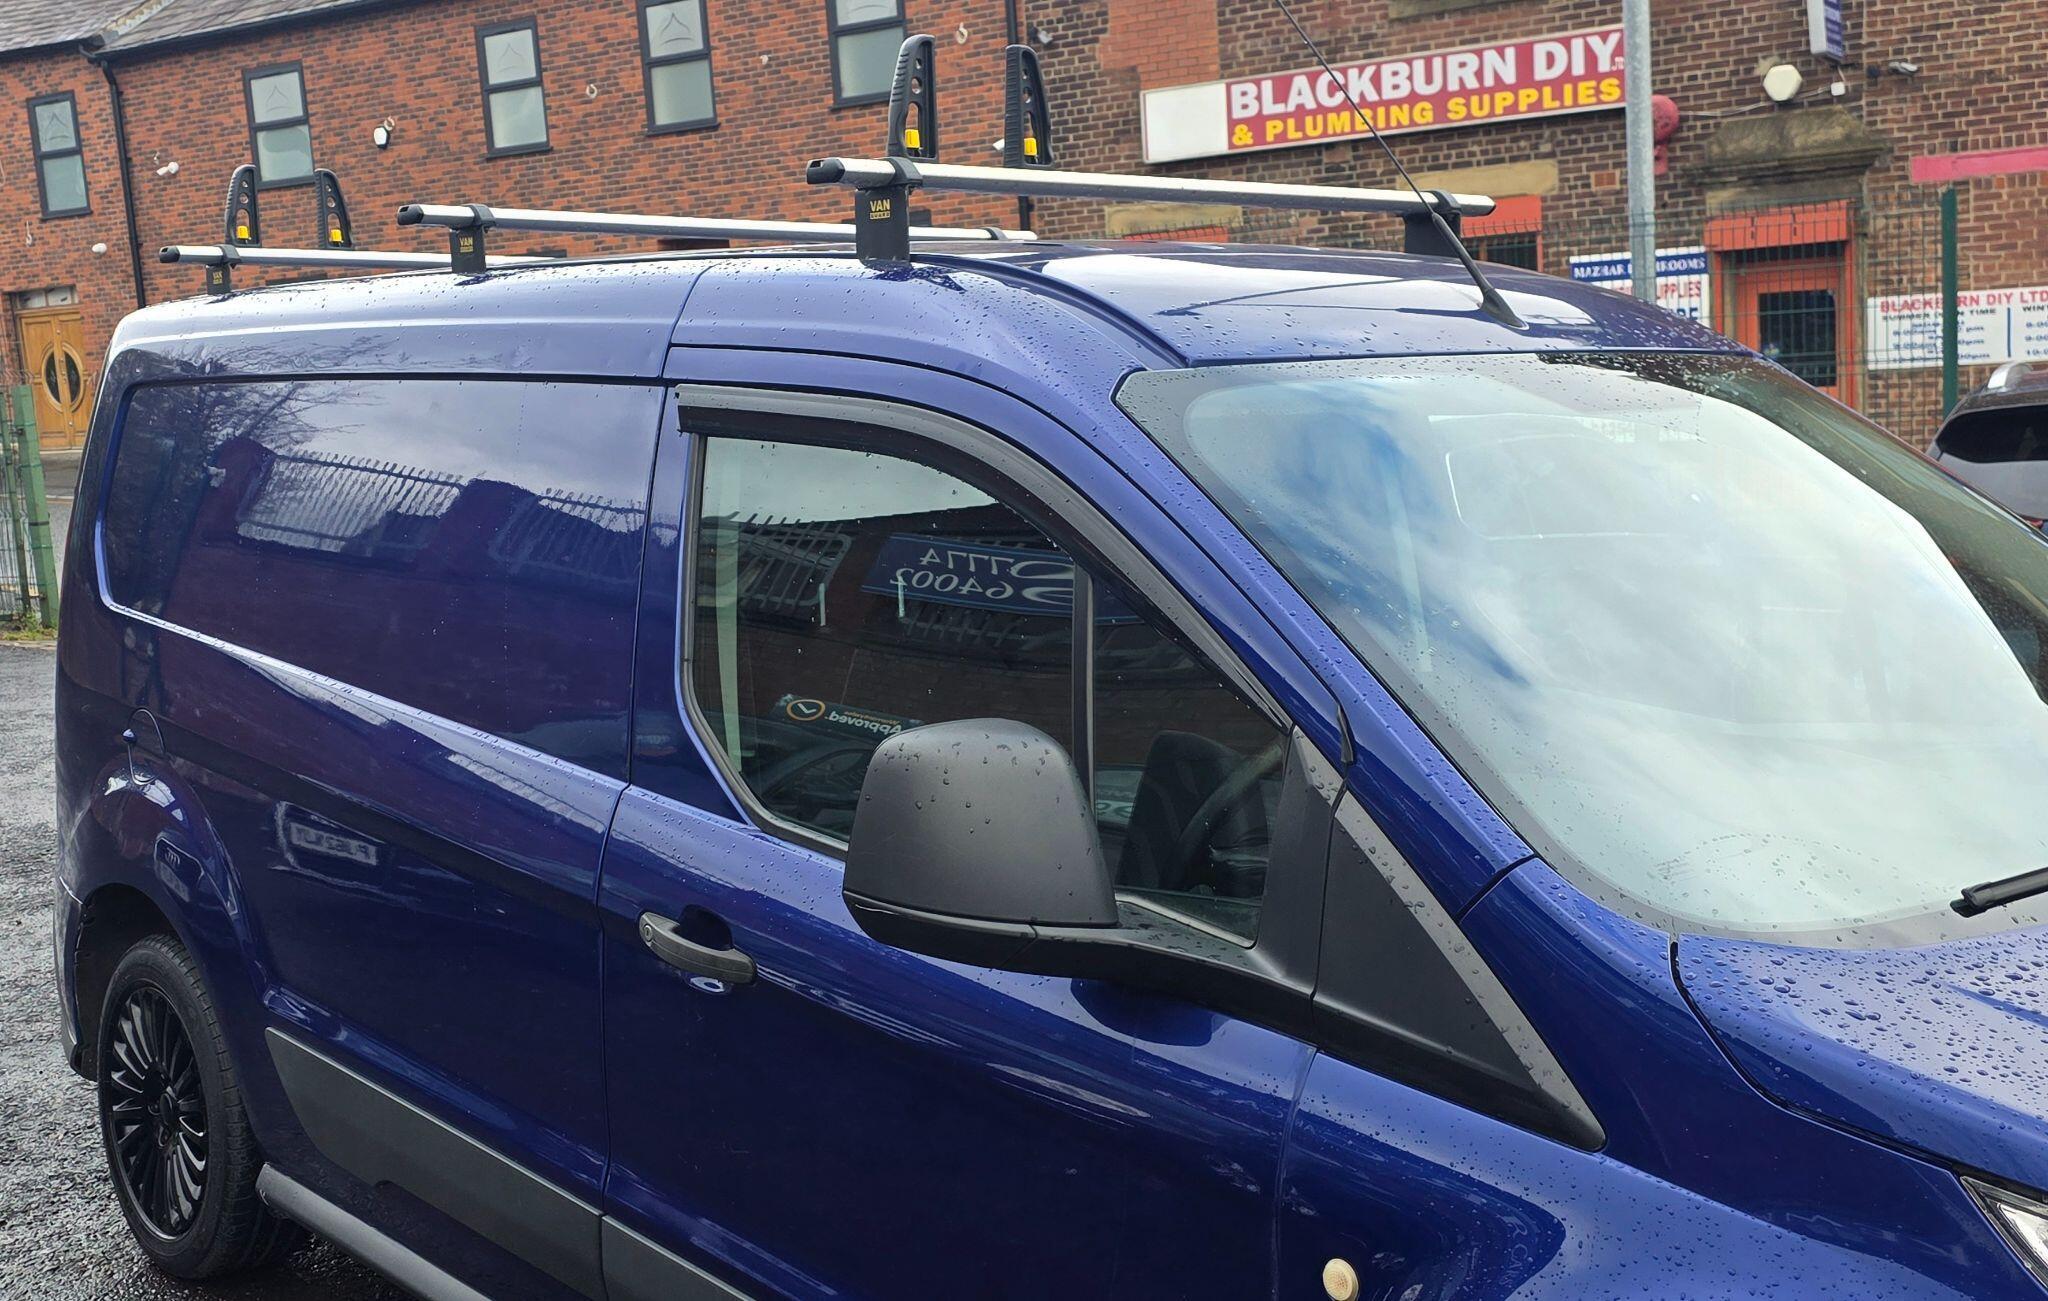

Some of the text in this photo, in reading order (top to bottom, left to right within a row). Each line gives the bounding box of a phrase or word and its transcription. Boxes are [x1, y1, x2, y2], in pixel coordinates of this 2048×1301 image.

[1230, 31, 1621, 119] BLACKBURN DIY
[1232, 77, 1621, 146] & PLUMBING SUPPLIES
[870, 199, 890, 212] VAN
[1657, 281, 1701, 299] PPLIES
[1880, 289, 2048, 313] BLACKBRN DIY LTD
